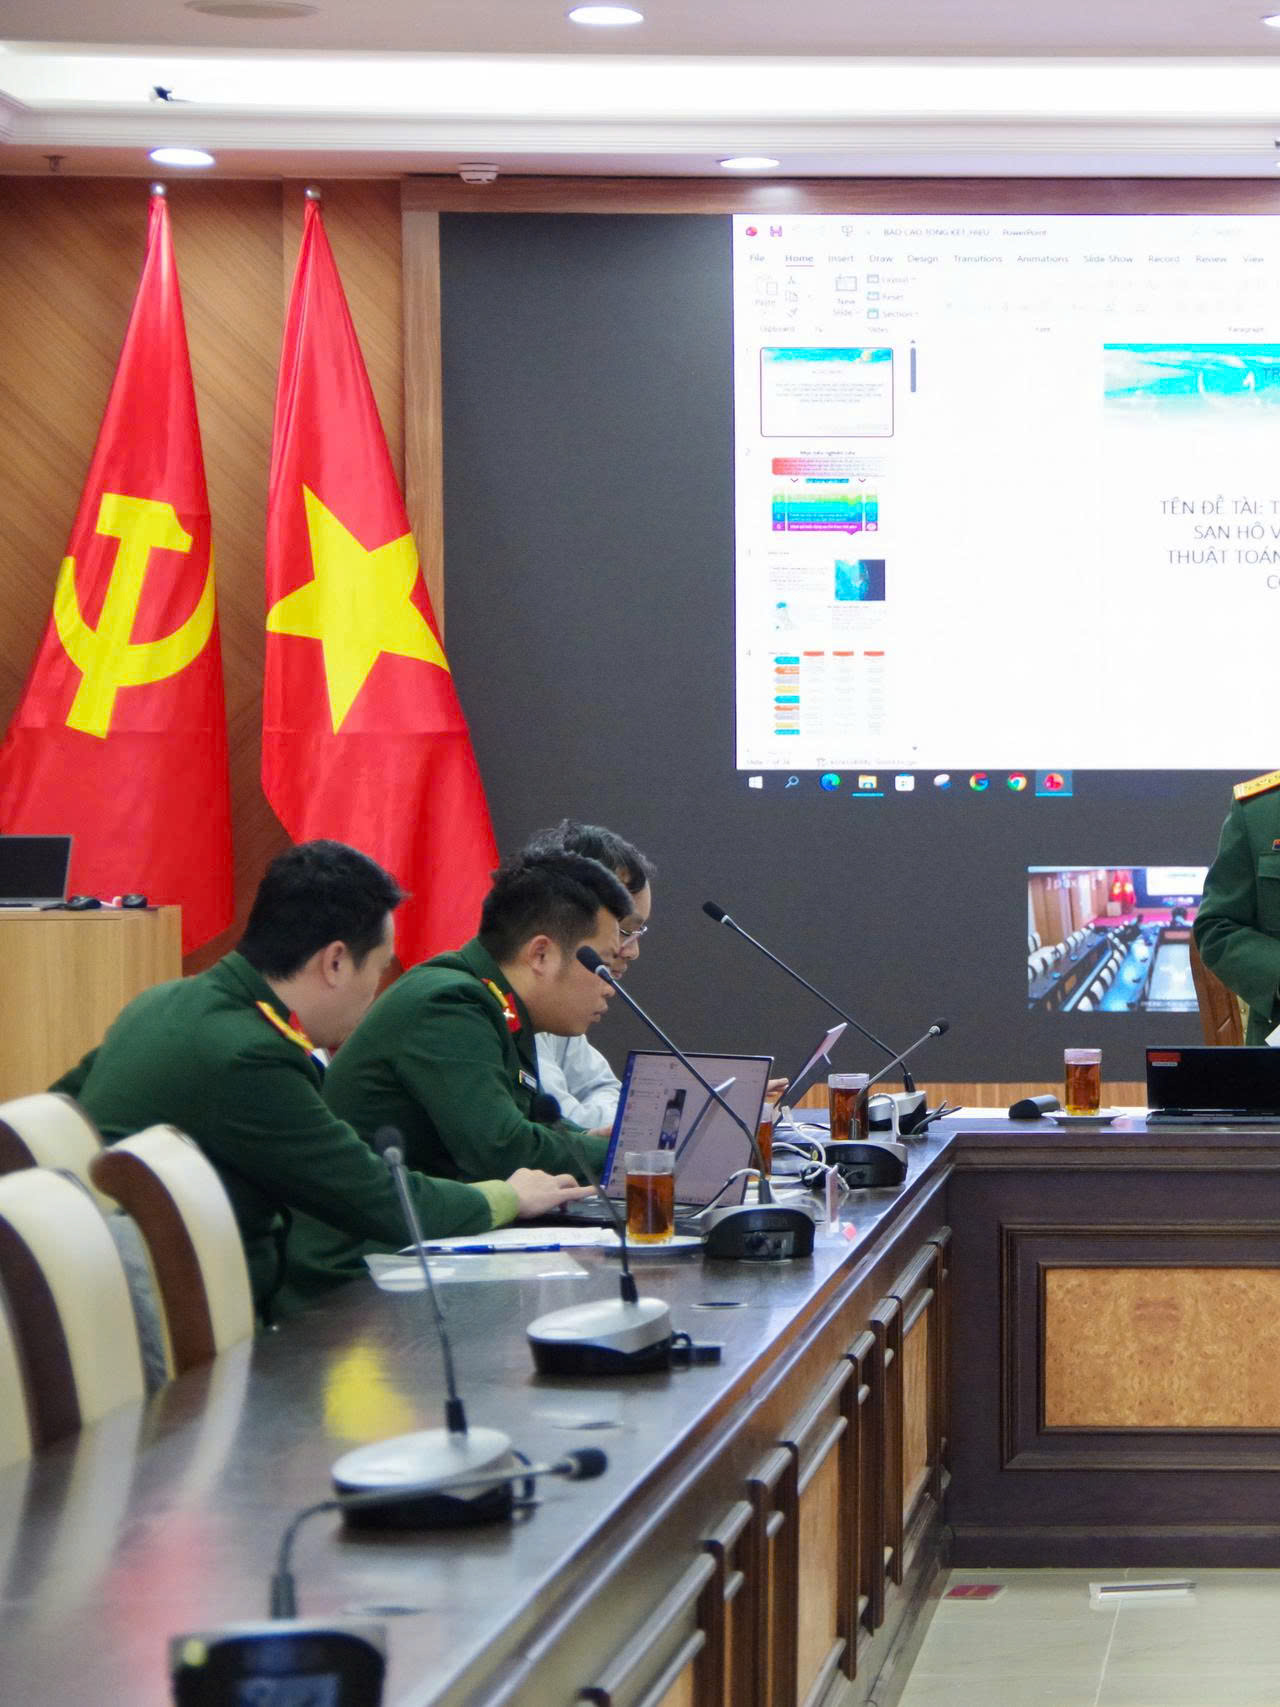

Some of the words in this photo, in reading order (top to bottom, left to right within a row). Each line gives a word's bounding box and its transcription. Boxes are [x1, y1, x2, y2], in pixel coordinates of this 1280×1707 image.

[784, 254, 814, 263] Home
[828, 254, 854, 263] Insert
[868, 254, 894, 263] Draw
[907, 254, 939, 265] Design
[953, 254, 1003, 264] Transitions
[1016, 254, 1069, 264] Animations
[1083, 254, 1105, 264] Slide
[1107, 254, 1135, 264] Show
[1147, 254, 1181, 264] Record
[1195, 254, 1228, 264] Review
[1242, 254, 1265, 264] View
[1160, 495, 1195, 515] TÊN
[1201, 493, 1224, 515] ĐỀ
[1231, 495, 1264, 515] TÀI:
[1193, 524, 1231, 540] SAN
[1237, 520, 1265, 540] HÔ
